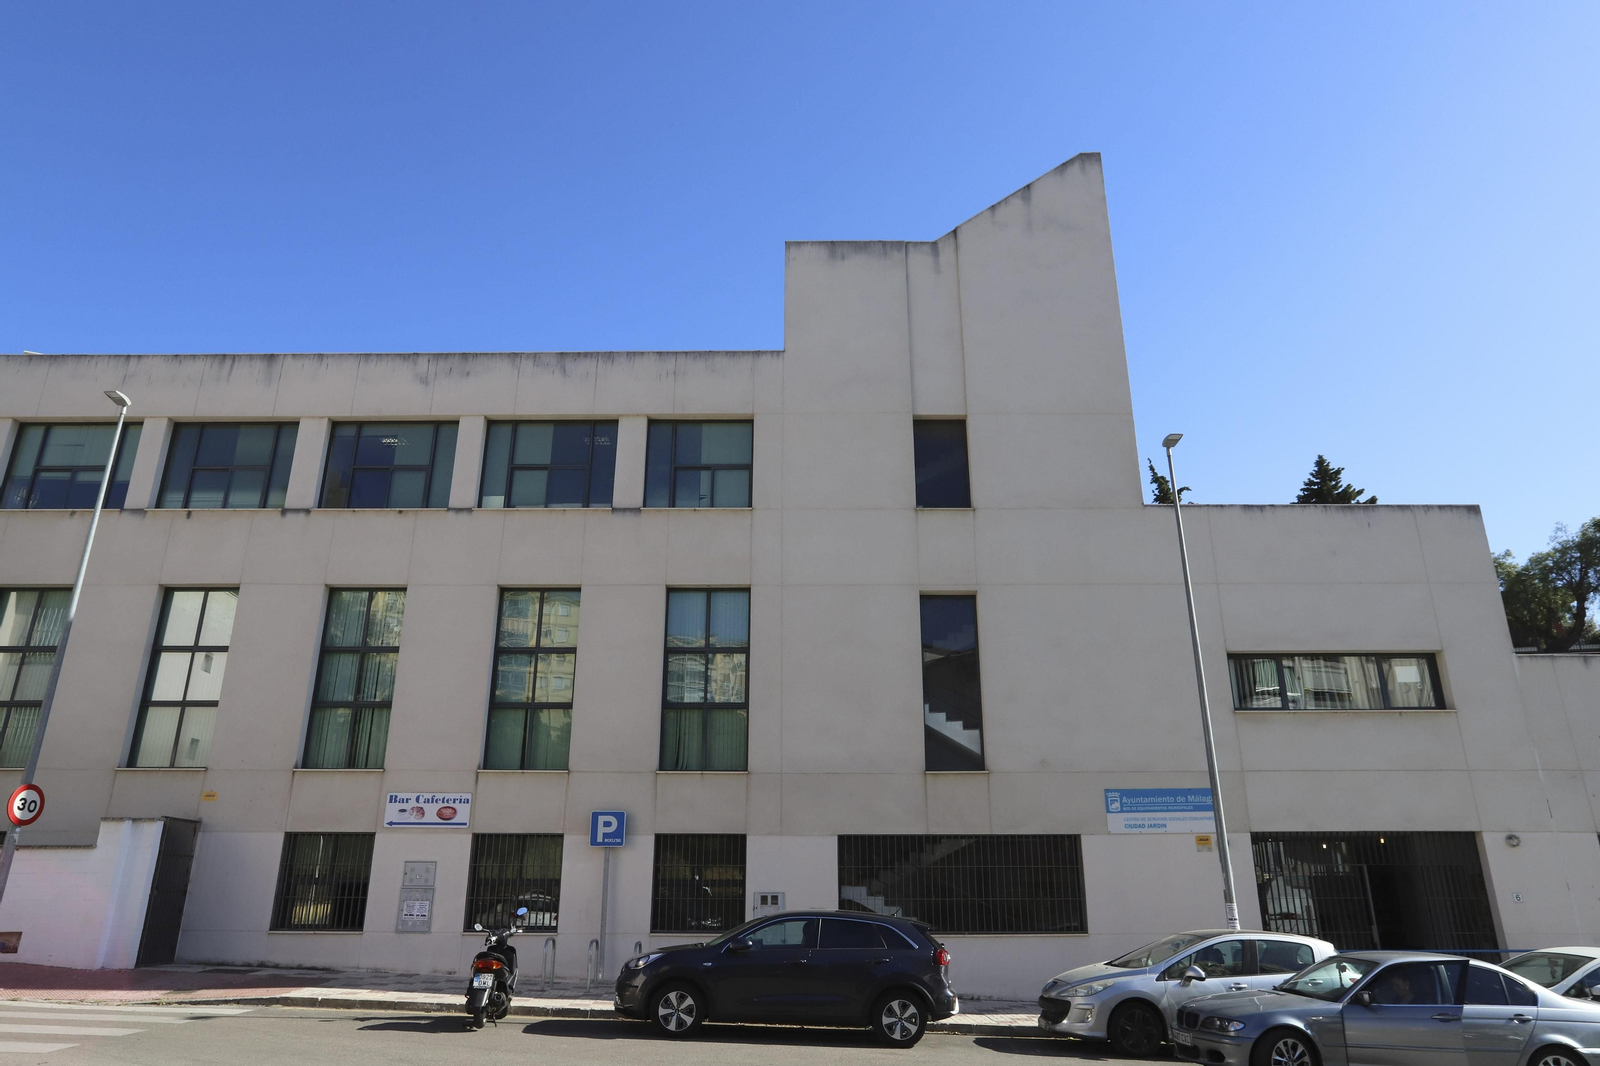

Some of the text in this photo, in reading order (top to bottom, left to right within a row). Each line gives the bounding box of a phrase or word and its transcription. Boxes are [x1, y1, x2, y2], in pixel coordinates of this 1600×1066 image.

[388, 794, 470, 804] Bar Cafetería
[1122, 795, 1213, 805] Ayuntamiento de Málag
[17, 797, 37, 813] 30
[596, 815, 618, 843] P
[1515, 893, 1522, 902] 6
